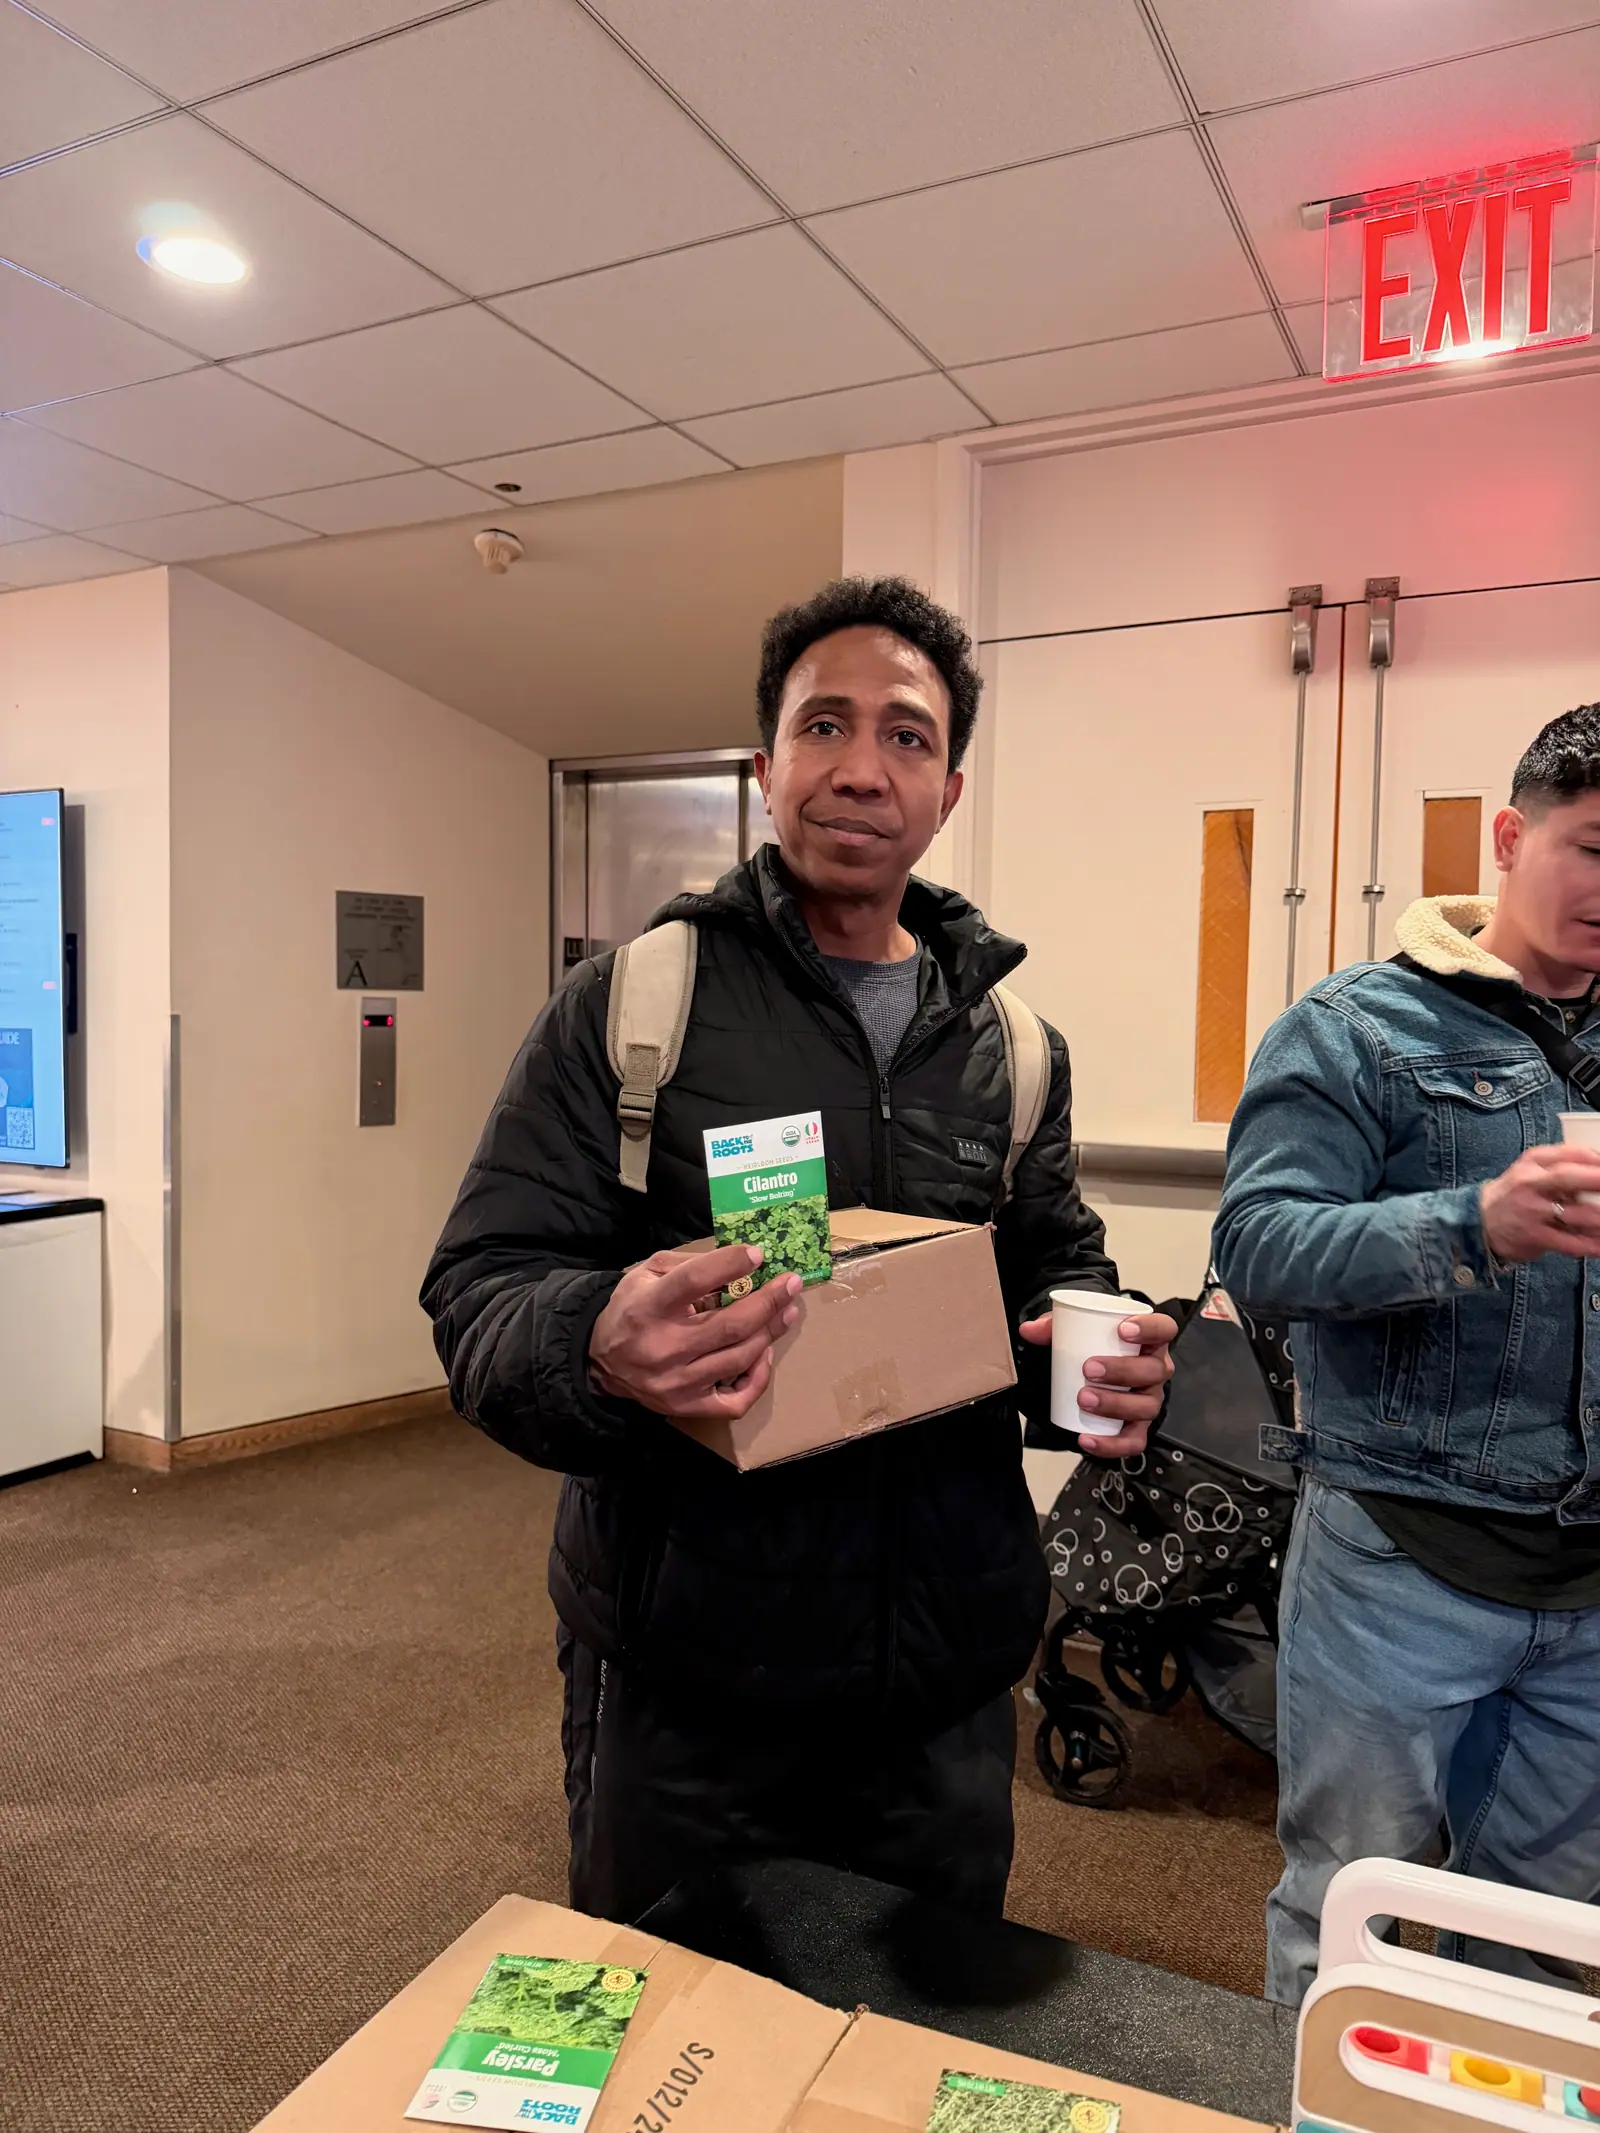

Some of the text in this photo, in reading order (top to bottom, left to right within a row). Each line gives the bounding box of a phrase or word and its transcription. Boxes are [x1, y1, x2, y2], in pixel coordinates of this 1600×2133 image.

[1360, 179, 1571, 365] EXIT
[346, 959, 368, 986] A
[711, 1137, 744, 1149] BACK
[712, 1144, 753, 1158] ROOTS
[744, 1172, 798, 1193] Cilantro
[481, 2049, 560, 2076] Parsley
[626, 2042, 715, 2133] S/012/2
[522, 2099, 582, 2114] ROOTS
[531, 2111, 578, 2126] BACK
